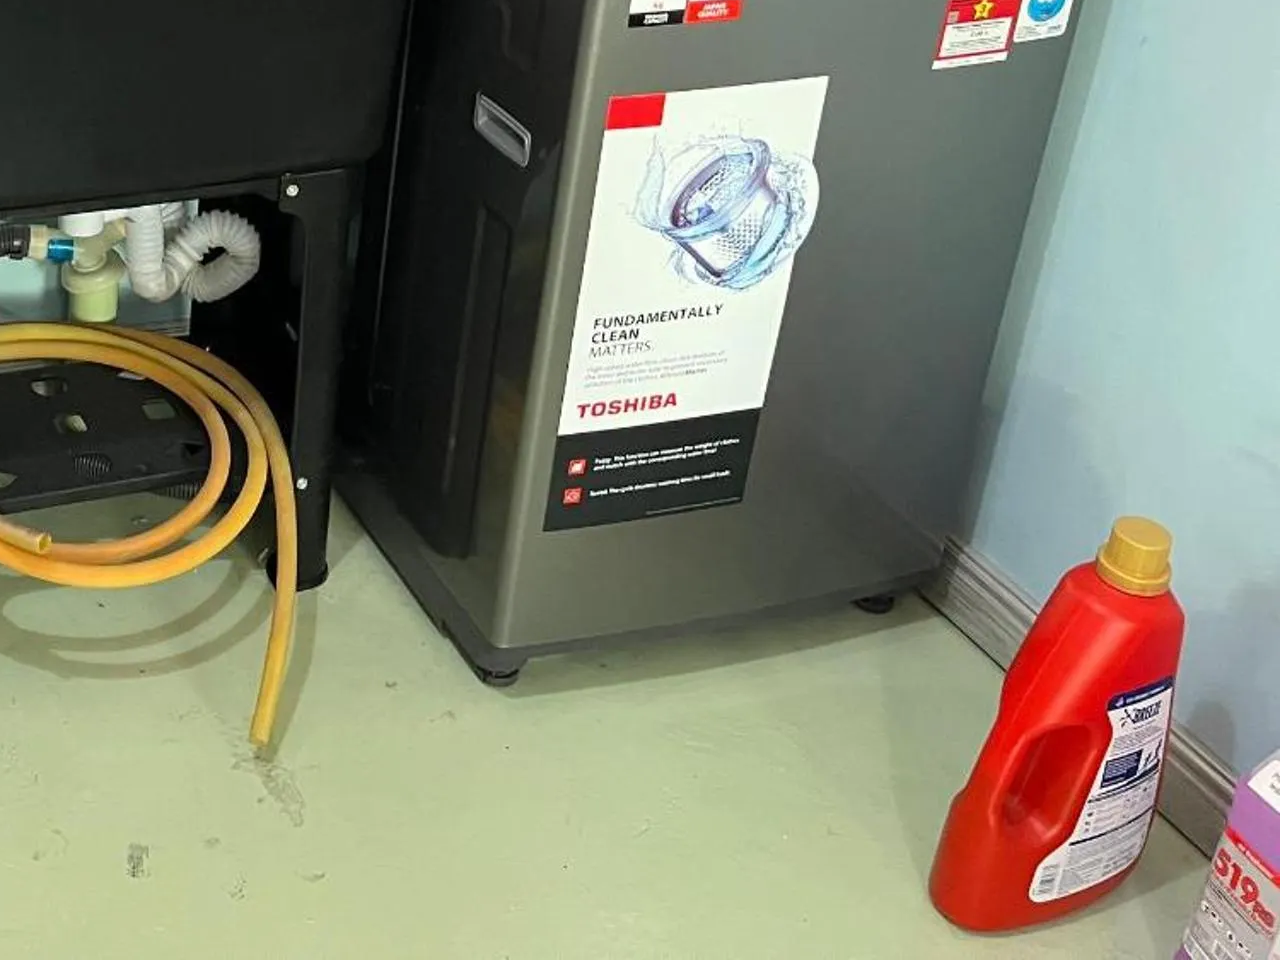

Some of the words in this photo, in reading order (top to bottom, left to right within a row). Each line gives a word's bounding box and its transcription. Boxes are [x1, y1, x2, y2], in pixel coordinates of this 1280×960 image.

[593, 304, 724, 329] FUNDAMENTALLY
[591, 328, 640, 344] CLEAN
[577, 393, 677, 418] TOSHIBA
